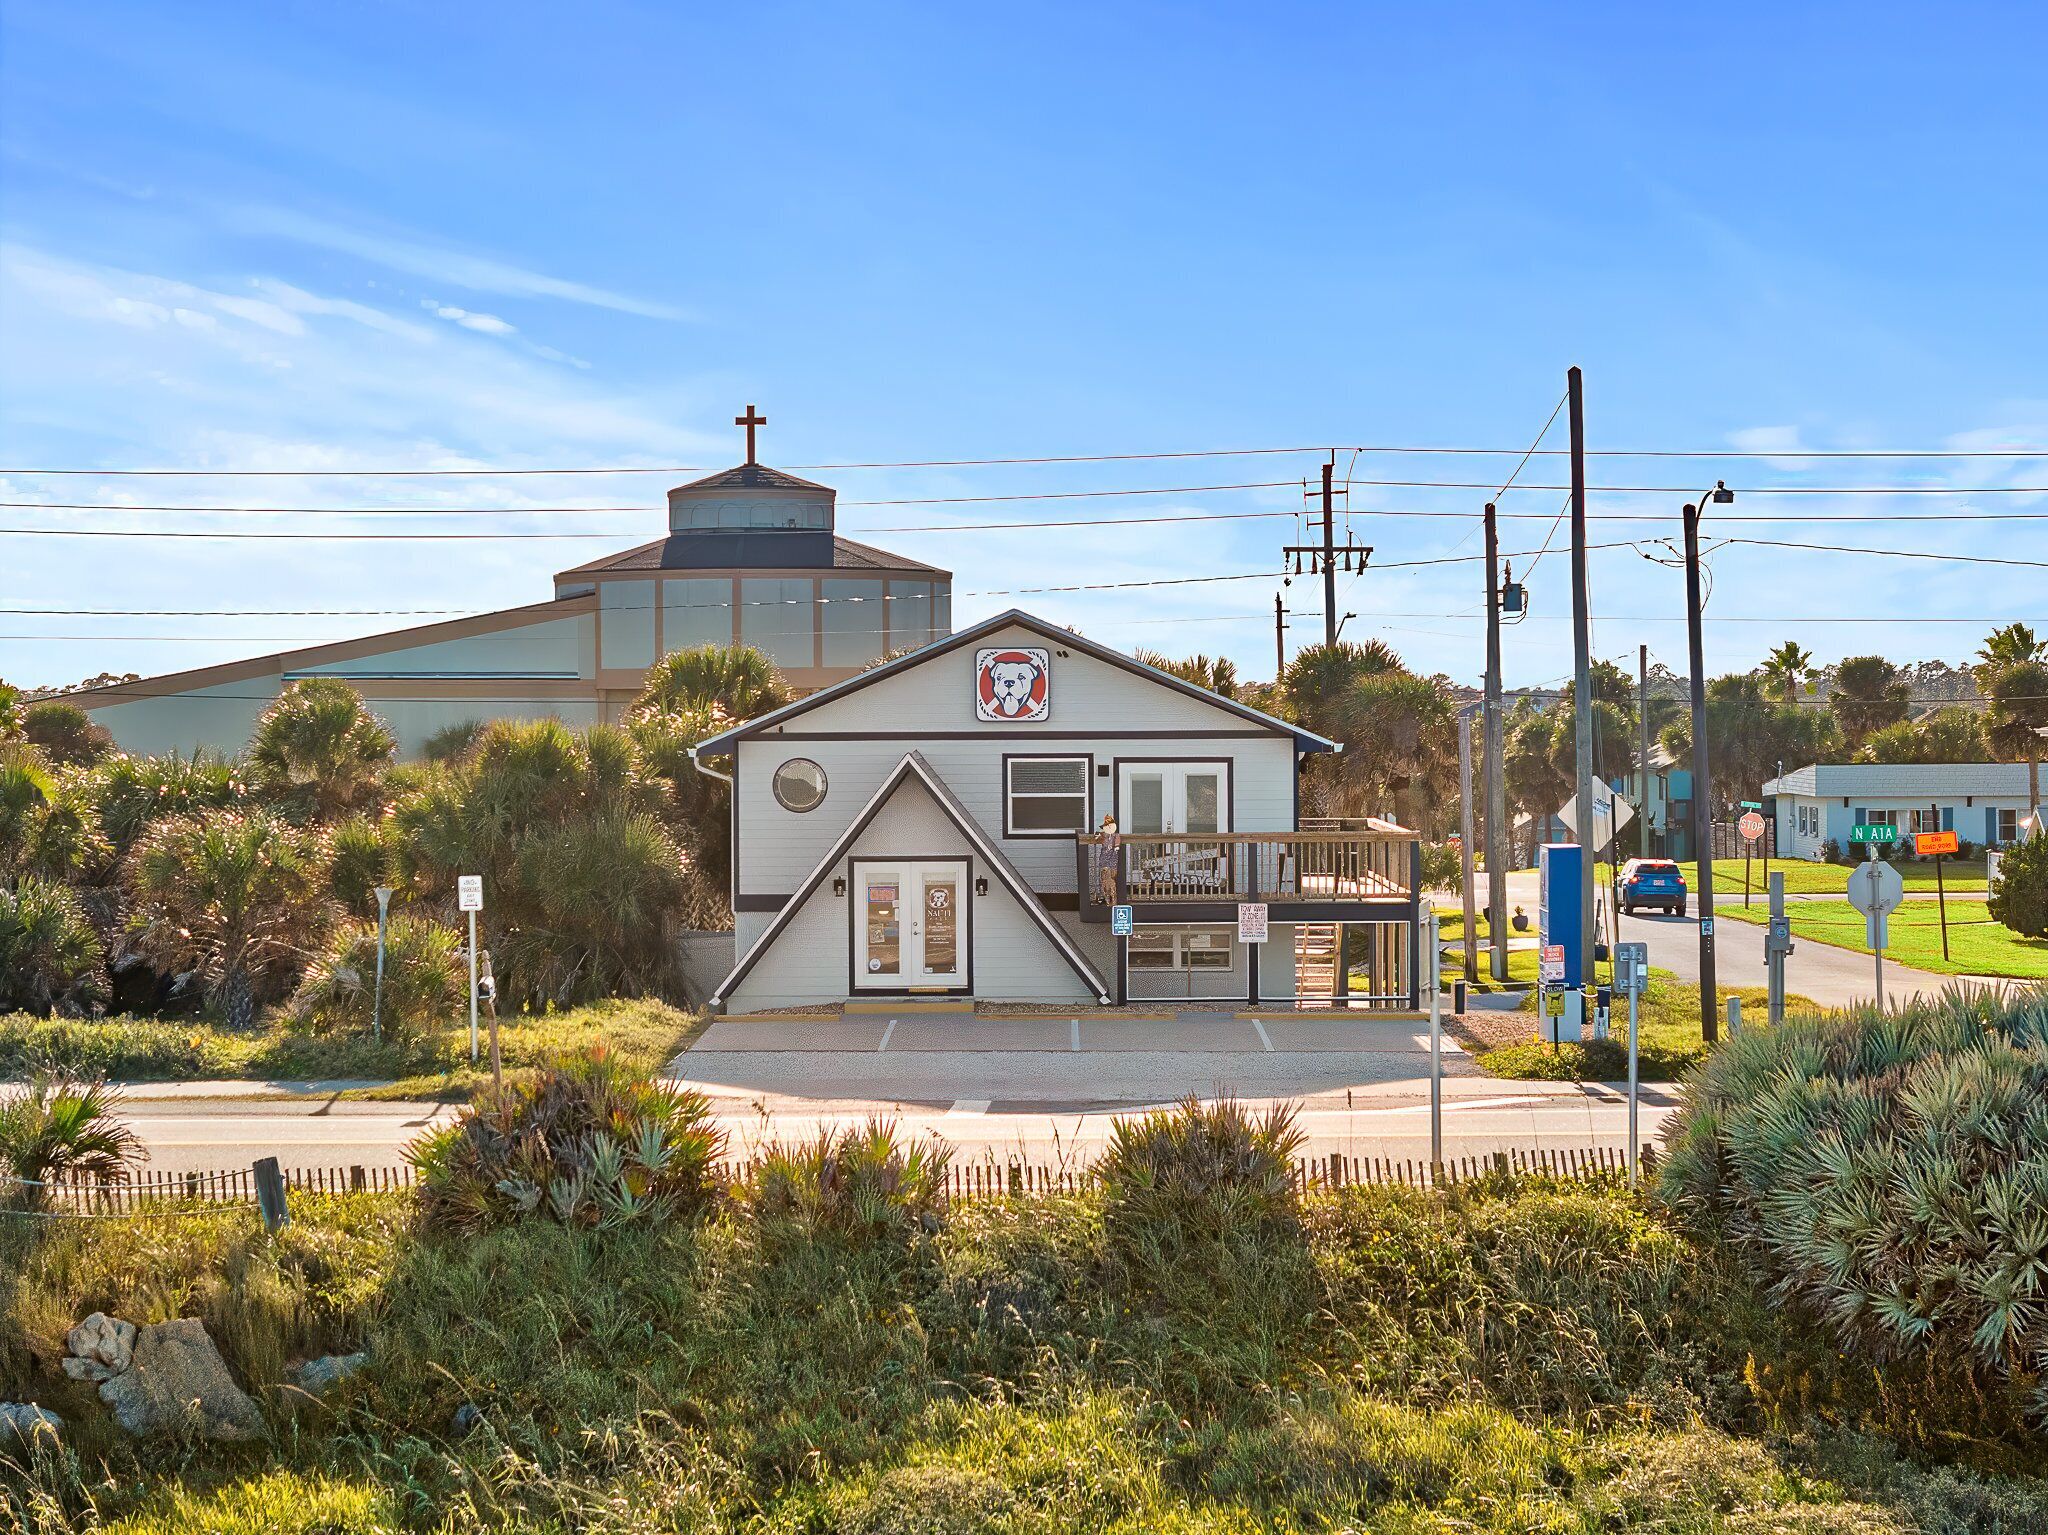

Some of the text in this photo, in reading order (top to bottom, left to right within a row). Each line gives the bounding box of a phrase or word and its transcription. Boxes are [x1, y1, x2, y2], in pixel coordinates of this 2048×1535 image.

[1740, 818, 1763, 831] STOP
[1855, 827, 1893, 840] N A1A
